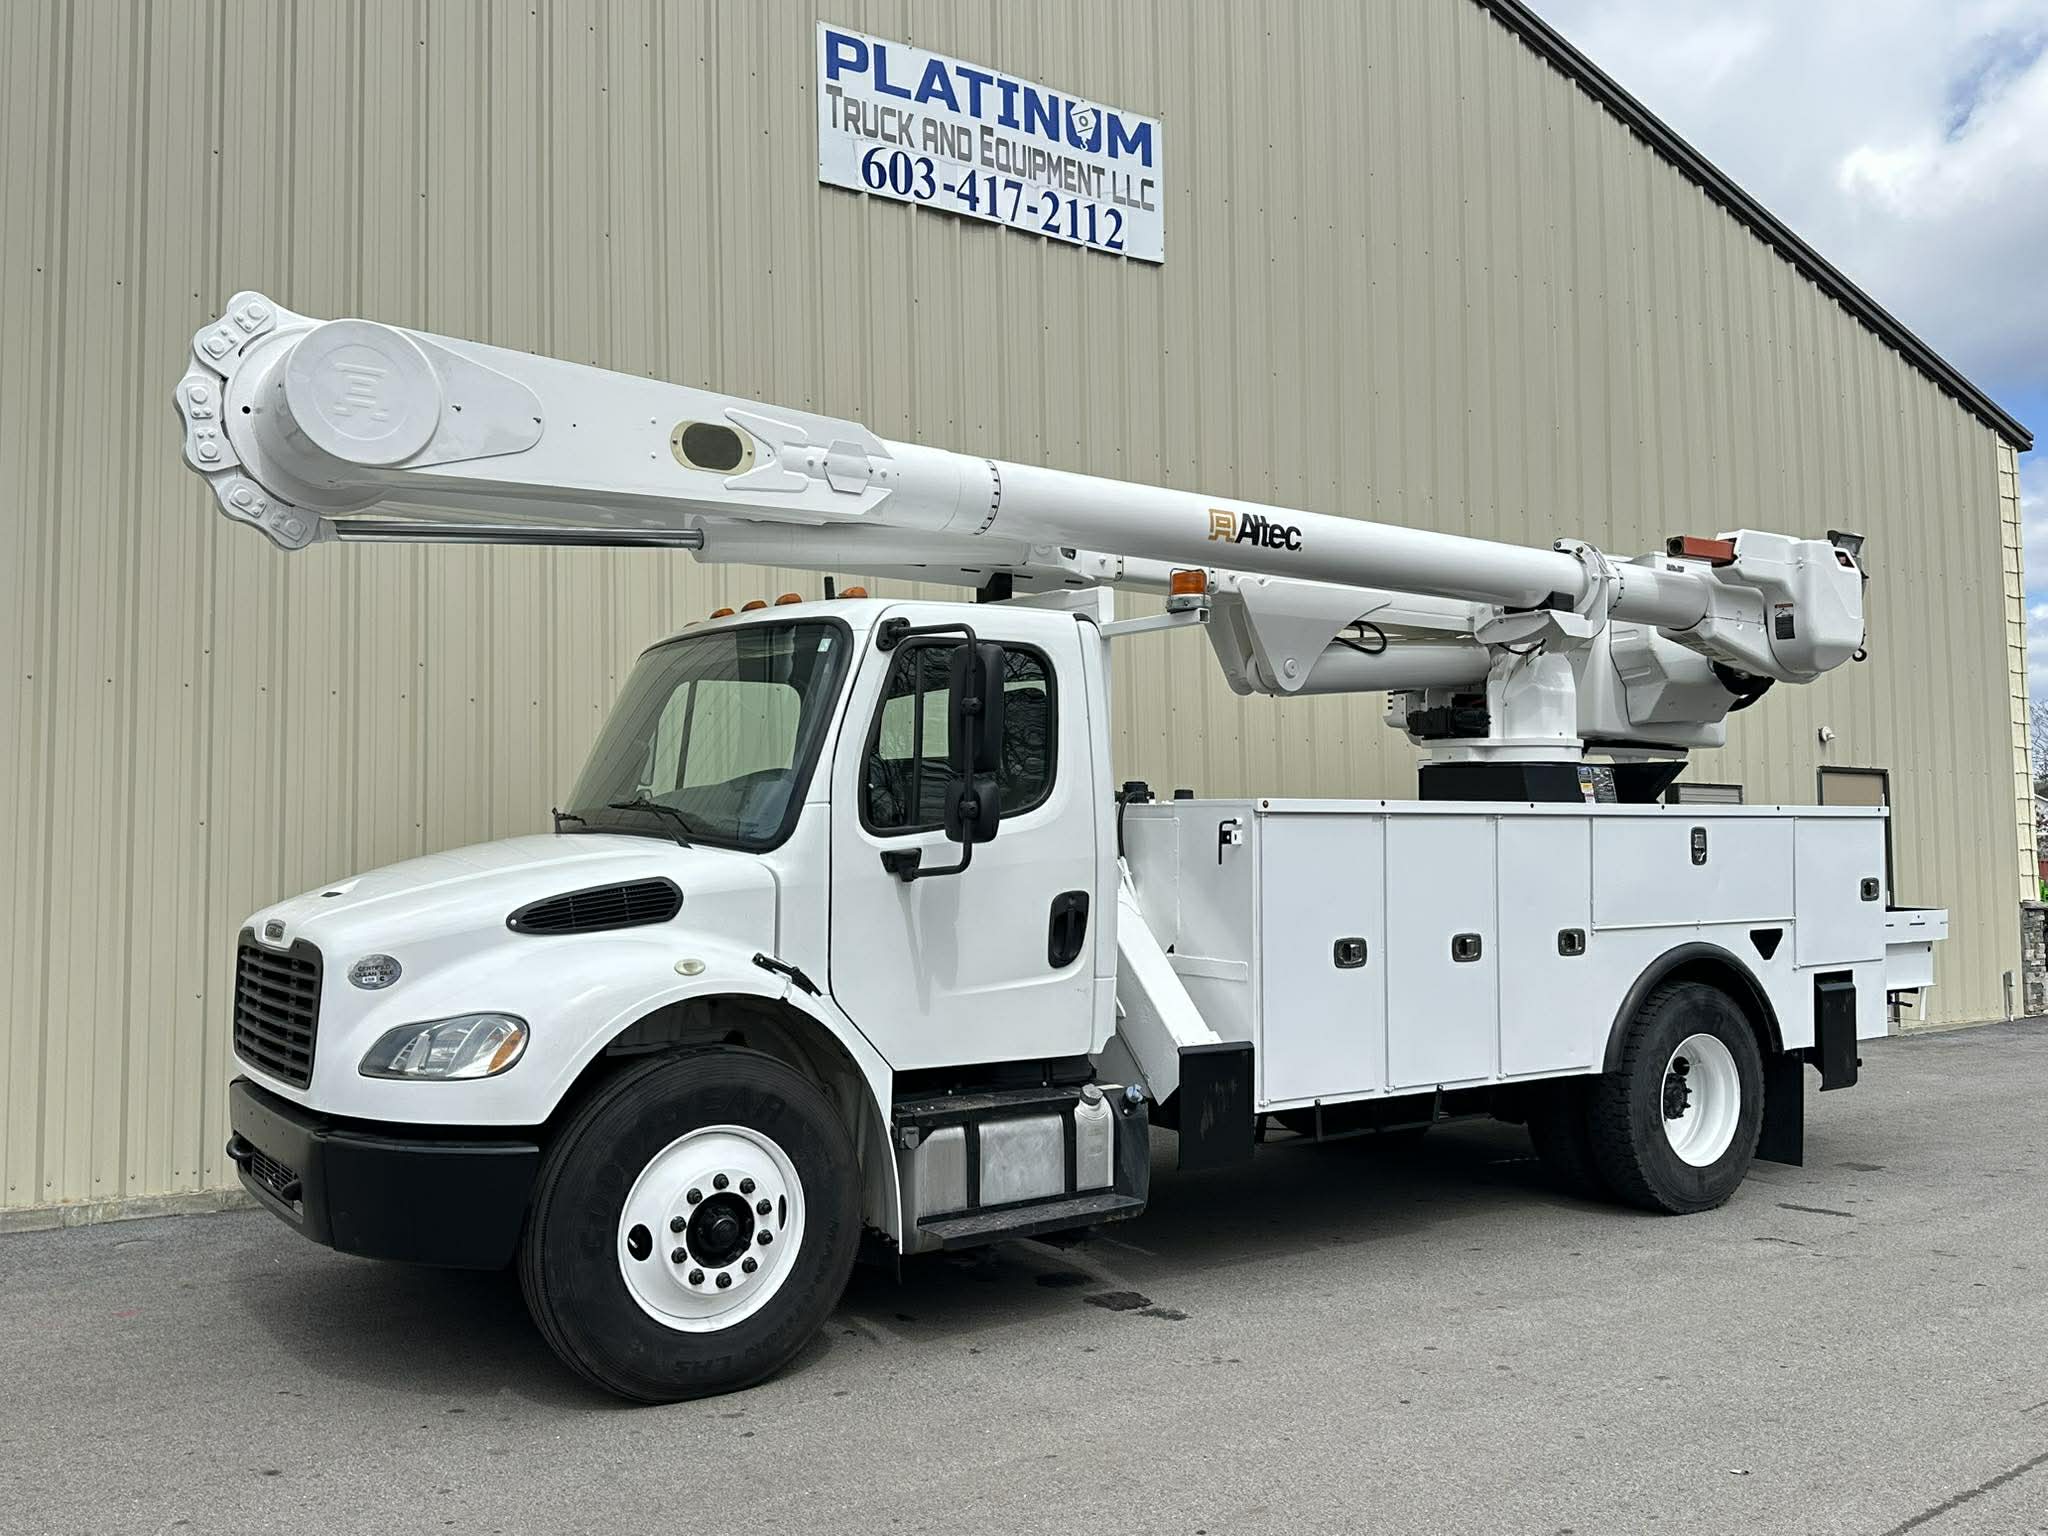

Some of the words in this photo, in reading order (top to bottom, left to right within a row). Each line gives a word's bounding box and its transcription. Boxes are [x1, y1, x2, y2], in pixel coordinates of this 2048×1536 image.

[826, 30, 1152, 168] PLATINUM
[826, 84, 915, 148] TRUCK
[922, 117, 972, 163] AND
[980, 124, 1105, 199] EQUIPMENT
[1112, 171, 1155, 212] LLC
[861, 147, 1124, 250] 603-417-2112
[1235, 513, 1302, 551] Altec
